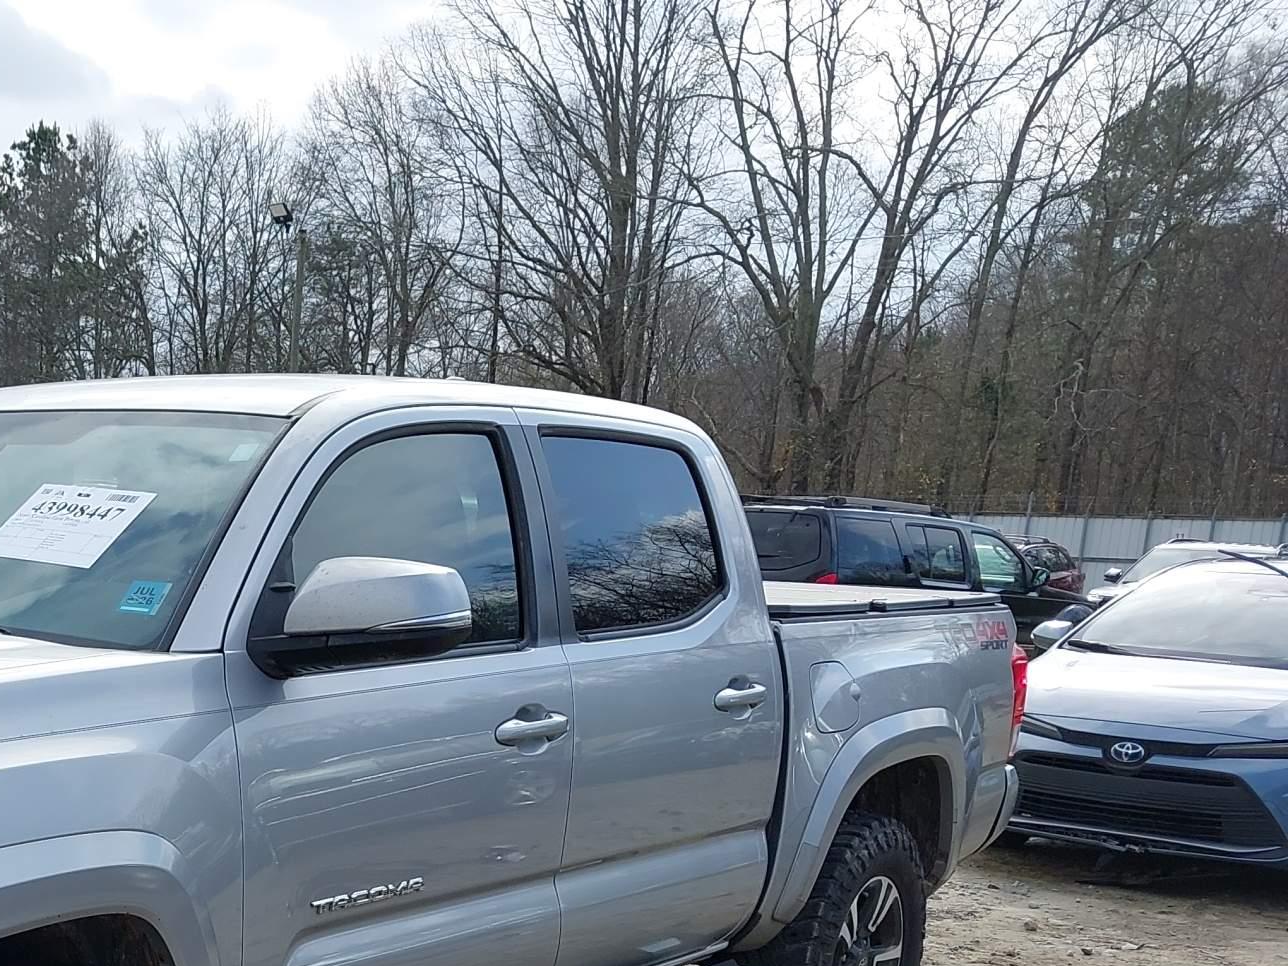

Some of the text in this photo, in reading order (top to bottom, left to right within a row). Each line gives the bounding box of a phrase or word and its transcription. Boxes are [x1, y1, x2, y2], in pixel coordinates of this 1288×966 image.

[31, 500, 127, 520] 43998447
[132, 586, 155, 596] JUL
[979, 639, 1009, 651] SPORT
[310, 876, 424, 914] TACOMA
